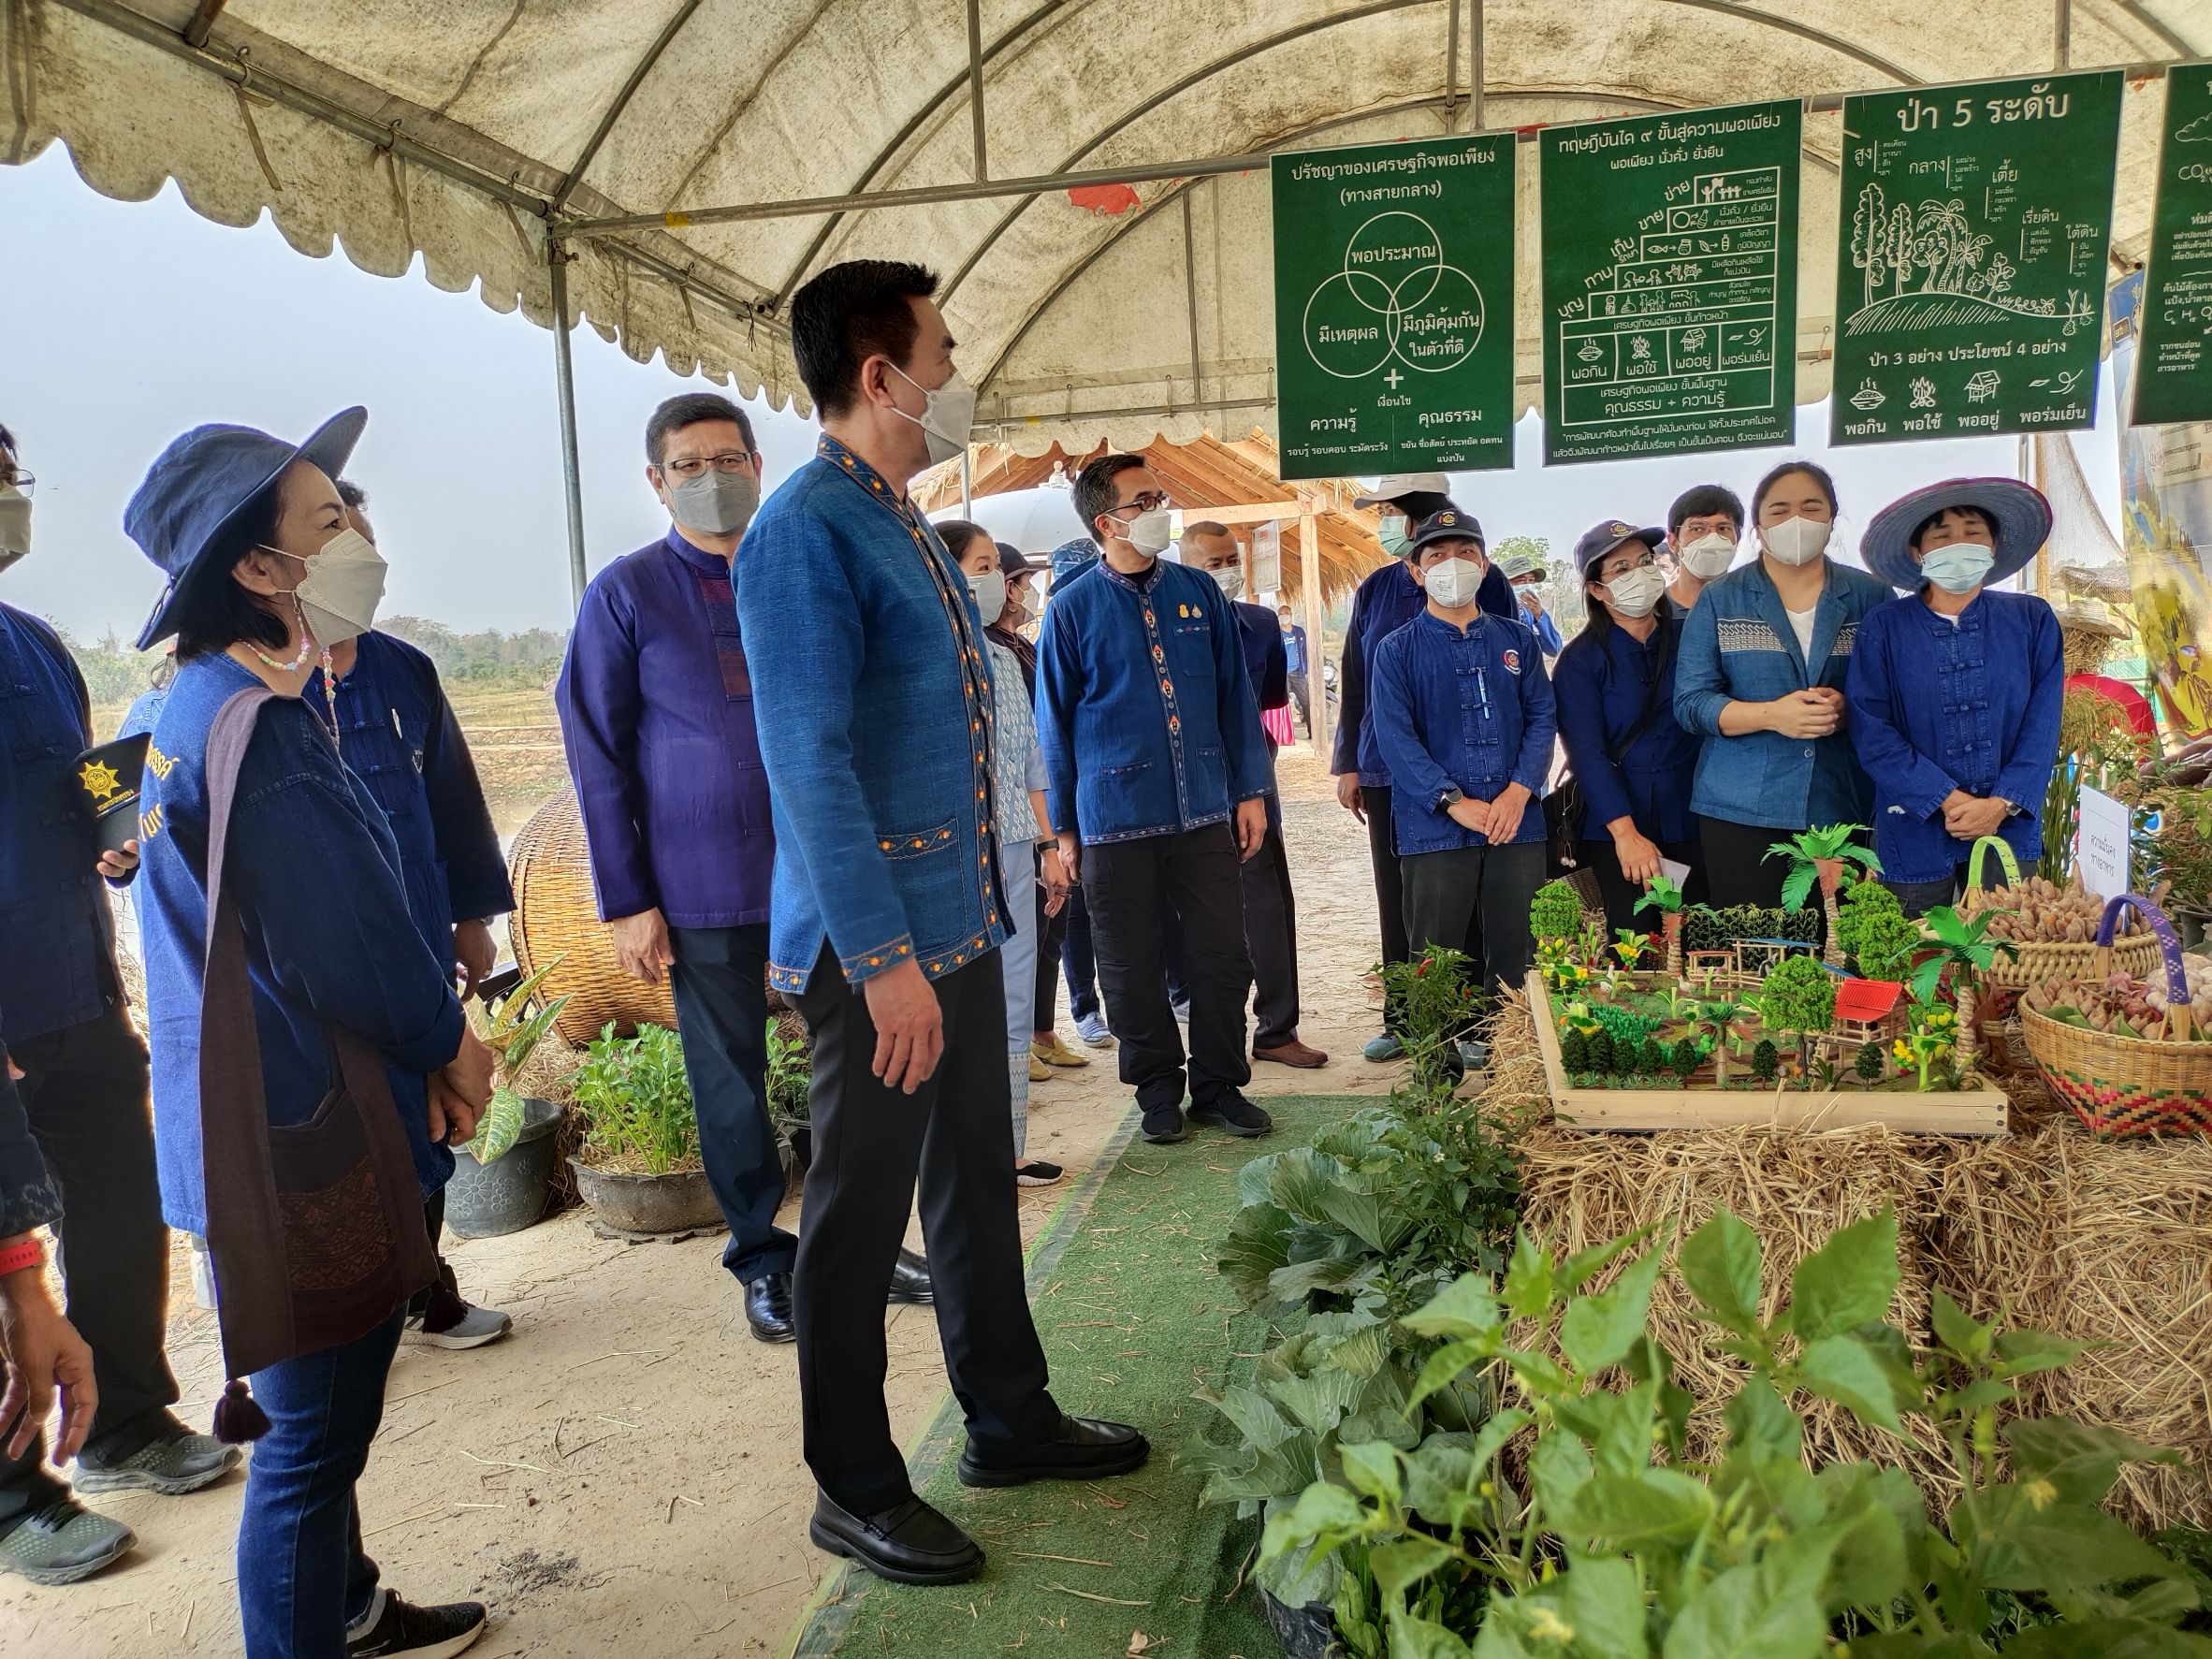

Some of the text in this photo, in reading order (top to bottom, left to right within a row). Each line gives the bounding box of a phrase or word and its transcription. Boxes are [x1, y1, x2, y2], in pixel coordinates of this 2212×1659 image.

[1897, 81, 2069, 133] ป่า 5 ระดับ
[1559, 129, 1635, 153] ทฤษฎีบันได
[1658, 113, 1781, 143] ขั้นสู่ความพอเพียง
[1291, 147, 1495, 182] ปรัชญาของเศรษฐกิจพอเพียง
[1610, 144, 1724, 170] พอเพียง มั่งคั่ง ยั่งยืน
[1855, 148, 1872, 167] สูง
[1909, 159, 1945, 175] กลาง
[1992, 158, 2017, 183] เตี้ย
[1340, 180, 1443, 207] (ทางสายกลาง)
[1664, 180, 1691, 201] ข่าย
[1638, 209, 1665, 230] ขาย
[1720, 204, 1740, 216] มั่งคั่ง
[1751, 202, 1772, 213] ยั่งยืน
[2022, 205, 2059, 225] เรี่ยดิน
[2065, 223, 2098, 240] ใต้ดิน
[1351, 245, 1436, 264] พอประมาณ
[1610, 237, 1635, 257] เก็บ
[1619, 248, 1639, 264] รักษา
[1583, 266, 1614, 289] ทาน
[1558, 297, 1585, 319] บุญ
[1404, 306, 1479, 335] มีภูมิคุ้มกัน
[1613, 310, 1729, 331] เศรษฐกิจพอเพียง ขั้นก้าวหน้า
[1319, 326, 1378, 344] มีเหตุผล
[1409, 336, 1464, 357] ในตัวที่ดี
[1869, 340, 2066, 367] ป่า 3 อย่าง ประโยชน์ 4 อย่าง
[1571, 349, 1770, 380] พอกิน พอใช้ พออยู่ พอร่มเย็น
[1600, 376, 1727, 398] เศรษฐกิจพอเพียง ขั้นพื้นฐาน
[1377, 394, 1411, 408] เงื่อนไข
[1605, 400, 1662, 417] คุณธรรม
[1681, 390, 1726, 408] ความรู้
[1310, 407, 1357, 433] ความรู้
[1419, 409, 1482, 429] คุณธรรม
[1844, 402, 2087, 436] พอกิน พอใช้ พออยู่ พอร่มเย็น
[1288, 443, 1389, 458] รอบรู้ รอบคอบ ระมัดระวัง
[1401, 440, 1417, 449] ขยัน
[1448, 436, 1477, 446] ประหยัด
[1479, 436, 1503, 444] อดทน
[1436, 451, 1465, 463] แบ่งปัน
